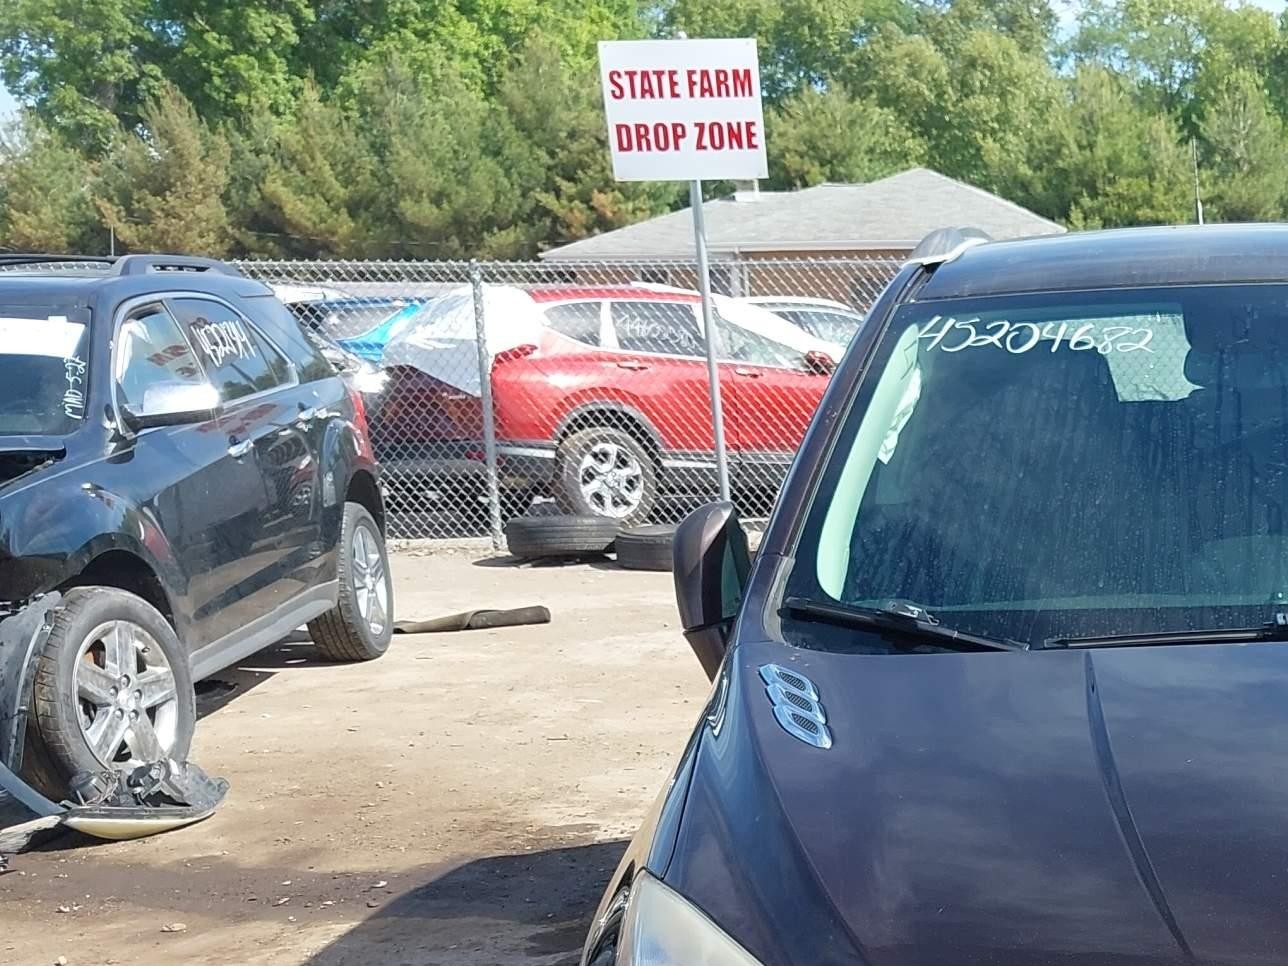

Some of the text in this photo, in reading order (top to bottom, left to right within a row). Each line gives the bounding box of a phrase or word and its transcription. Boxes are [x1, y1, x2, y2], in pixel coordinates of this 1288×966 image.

[609, 69, 753, 99] STATE FARM
[616, 121, 758, 152] DROP ZONE
[919, 315, 1154, 354] 45204682
[63, 389, 84, 420] MAD
